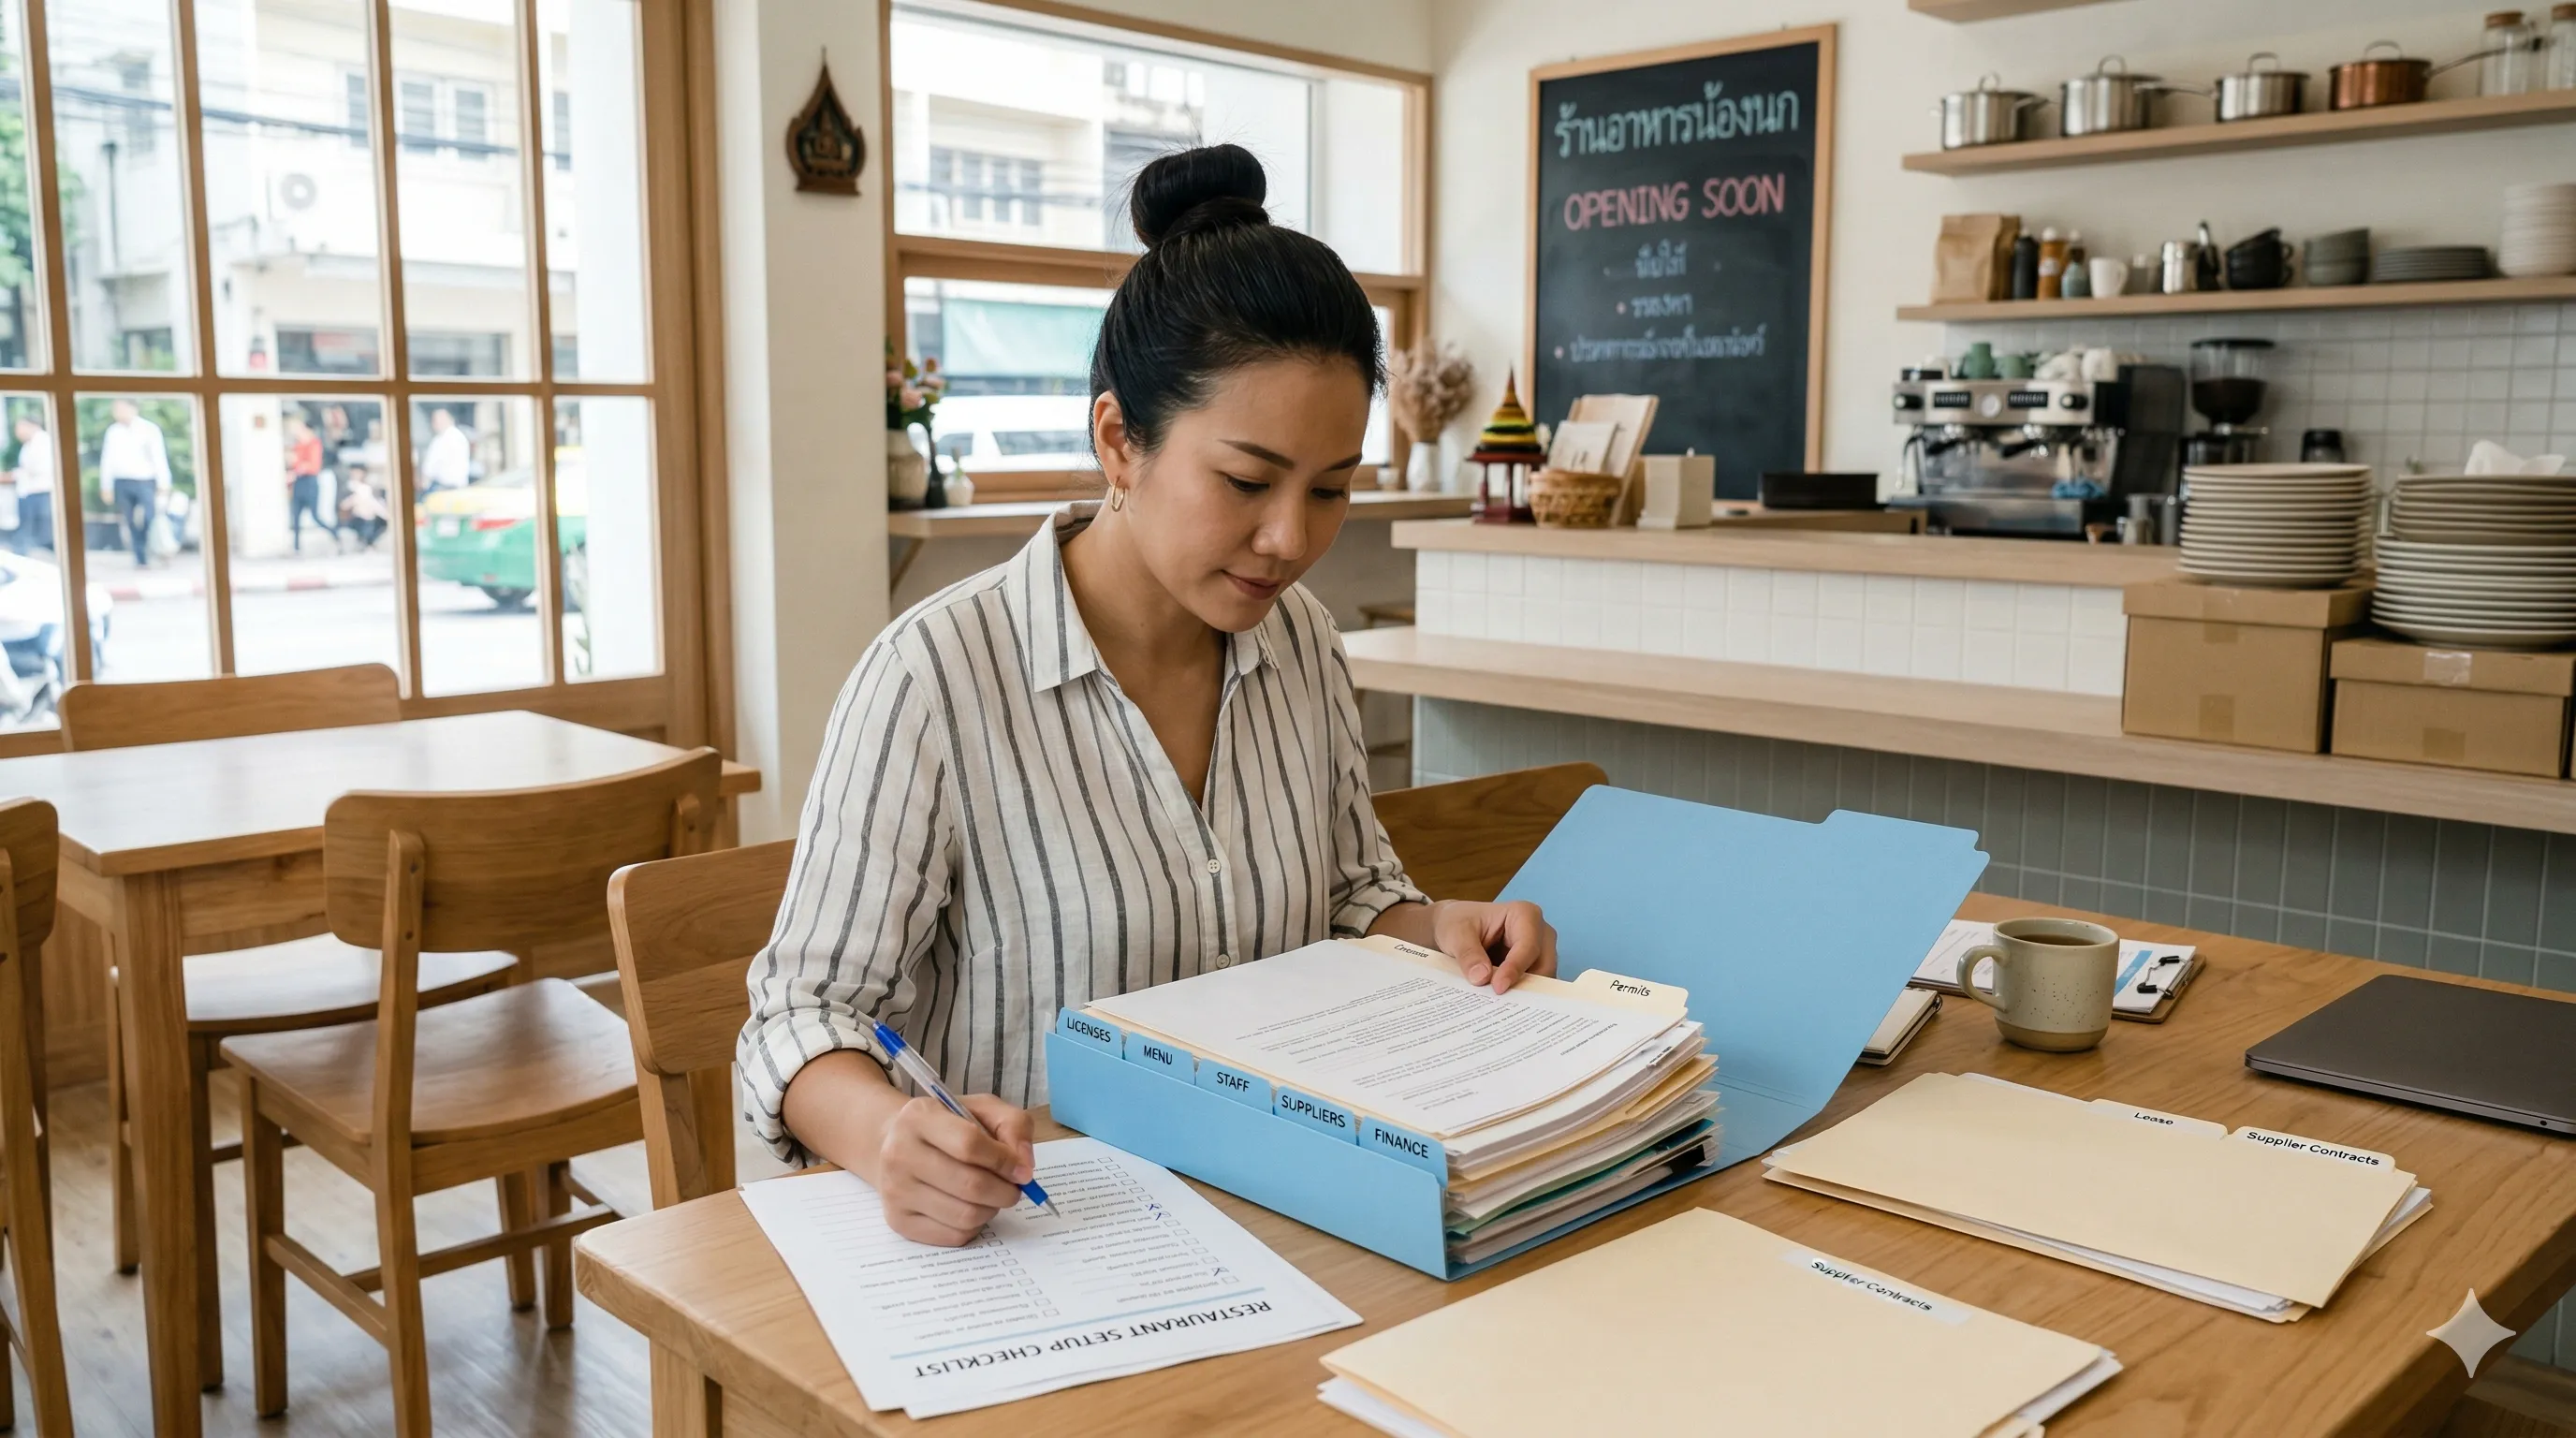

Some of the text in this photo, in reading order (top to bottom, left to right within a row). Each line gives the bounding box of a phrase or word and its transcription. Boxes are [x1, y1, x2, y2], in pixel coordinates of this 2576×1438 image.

[1554, 81, 1799, 157] ร้านอาหารน้องนก
[1563, 172, 1786, 231] OPENING SOON
[1609, 979, 1651, 997] Permits
[1066, 1017, 1112, 1044] LICENSES
[1143, 1044, 1173, 1066] MENU
[1216, 1071, 1251, 1093] STAFF
[1281, 1094, 1346, 1129] SUPPLIERS
[1374, 1127, 1429, 1159] FINANCE
[2309, 1144, 2380, 1167] Contracts
[915, 1300, 1273, 1378] RESTAURANT SETUP CHECKLIST
